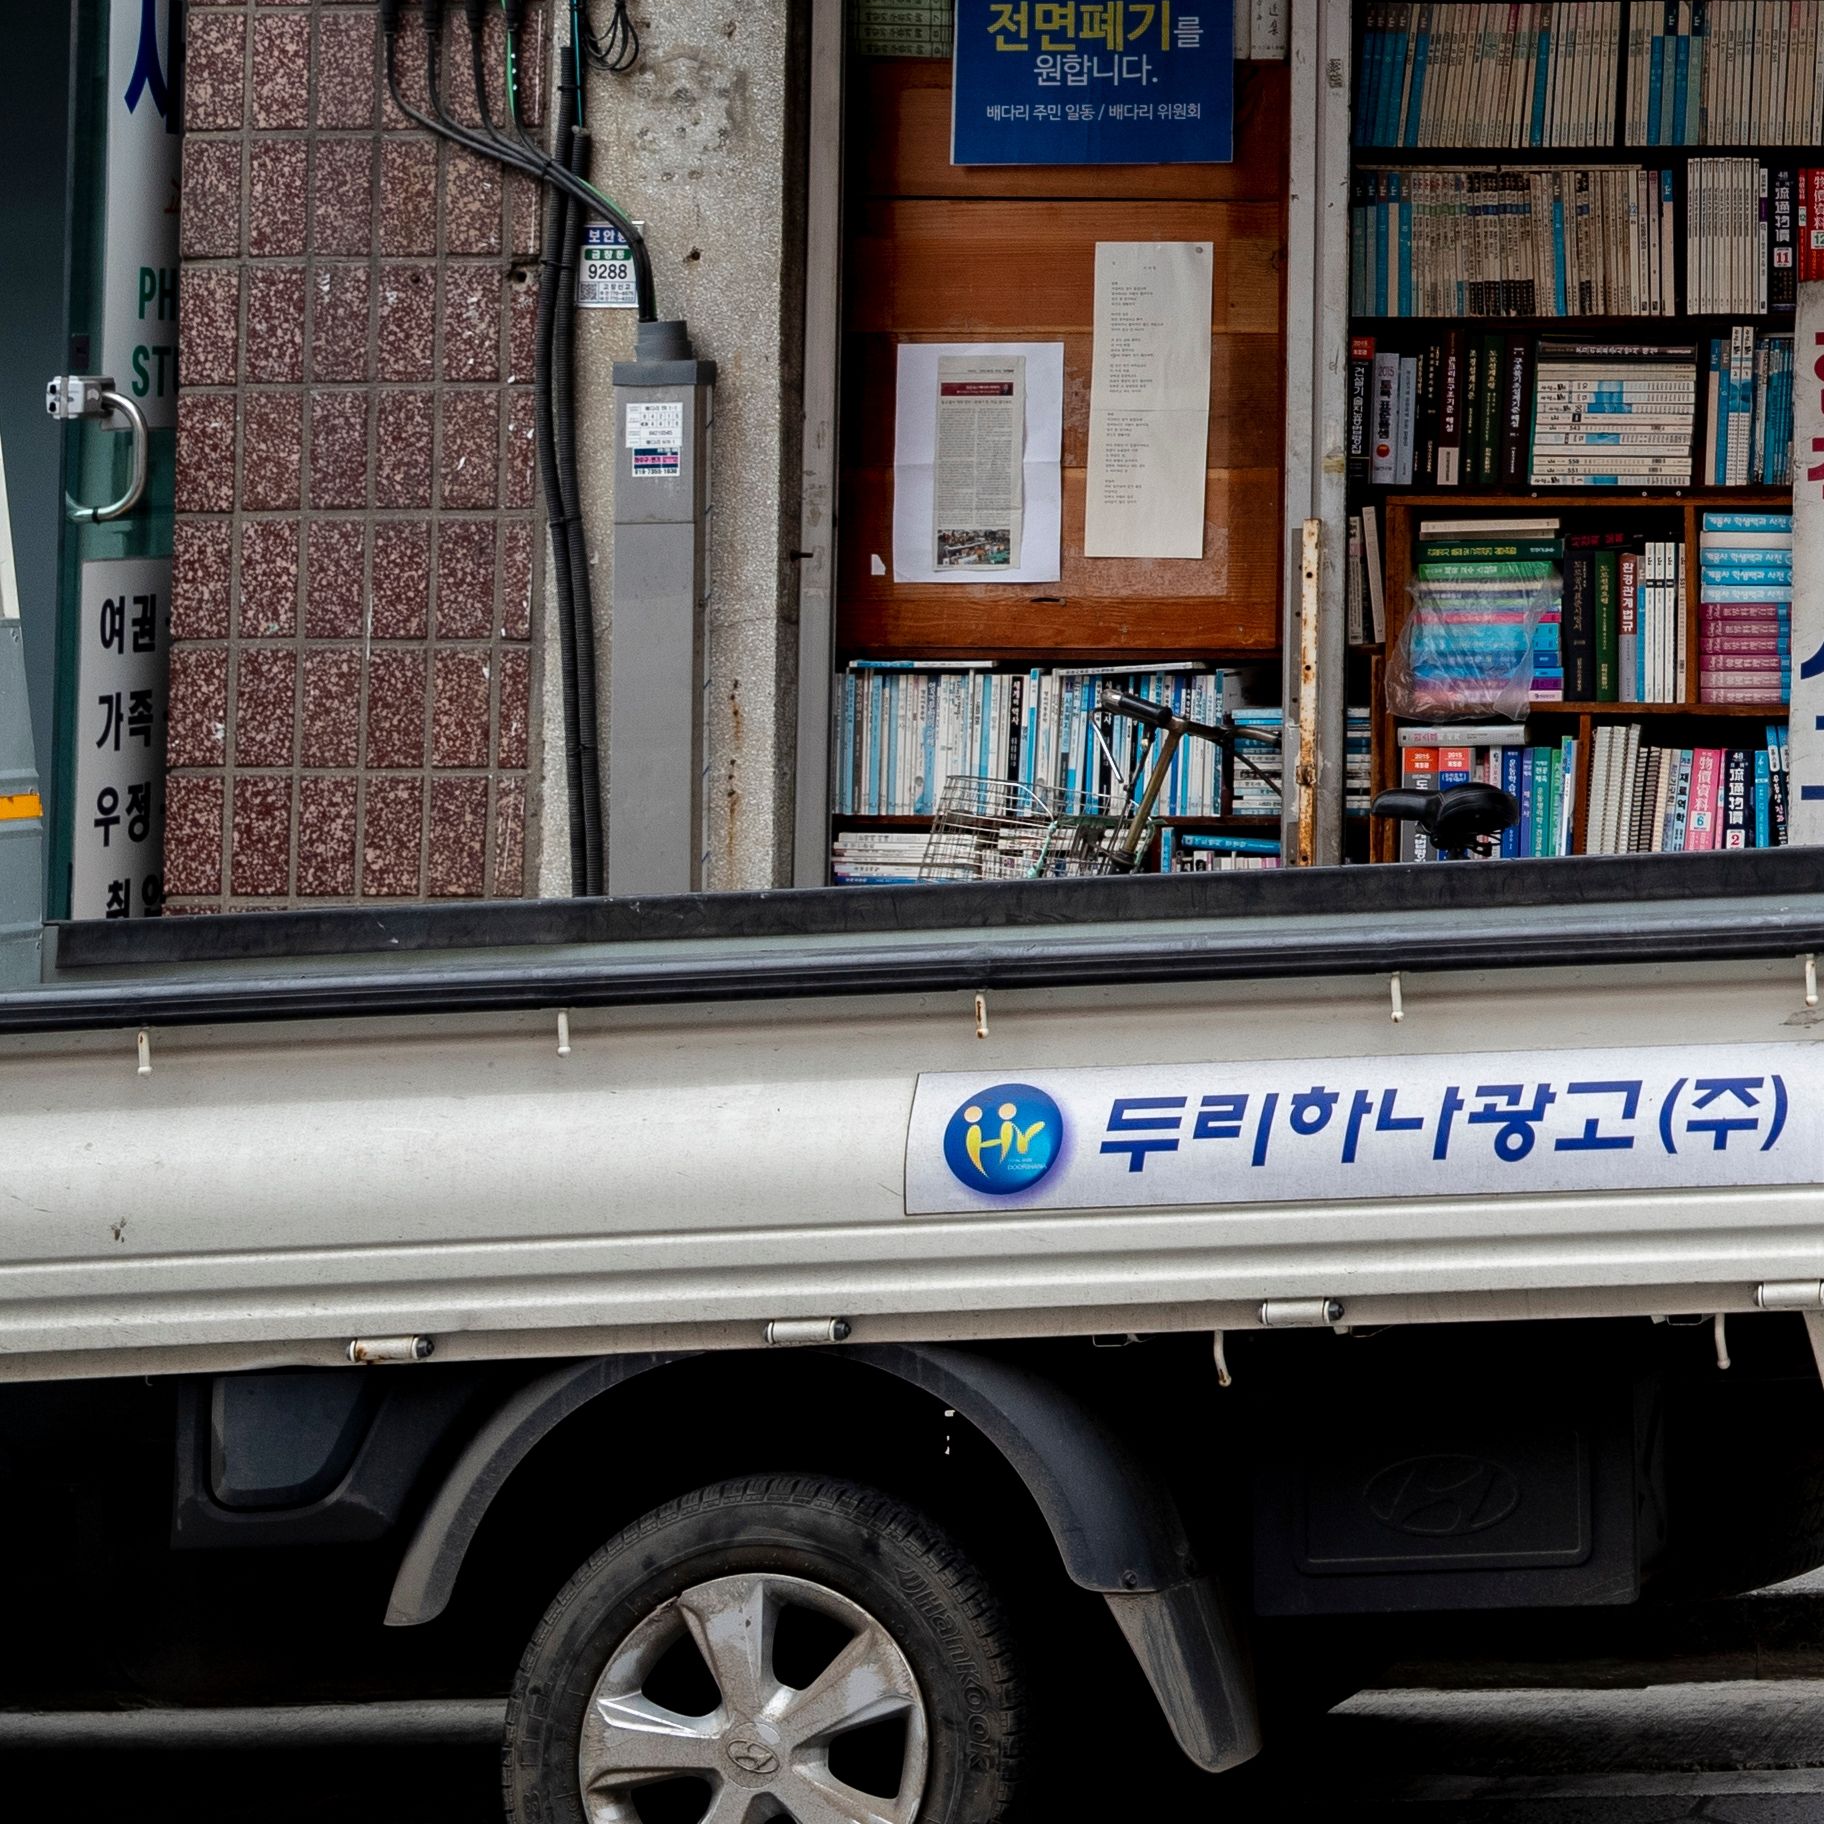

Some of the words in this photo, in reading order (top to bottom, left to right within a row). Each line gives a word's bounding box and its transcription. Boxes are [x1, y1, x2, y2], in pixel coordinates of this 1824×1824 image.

[986, 0, 1204, 52] 전면폐기를
[1034, 55, 1158, 86] 원합니다.
[987, 104, 1029, 121] 배다리
[1033, 105, 1061, 121] 주민
[1065, 105, 1096, 121] 일동
[1109, 104, 1153, 121] 배다리
[1157, 103, 1201, 119] 위원회
[1777, 251, 1789, 263] 11
[588, 264, 627, 279] 9288
[1696, 815, 1704, 826] 6
[1731, 833, 1740, 845] 2
[1099, 1072, 1790, 1174] 두리하나광고(주)
[908, 1587, 994, 1773] Hankook
